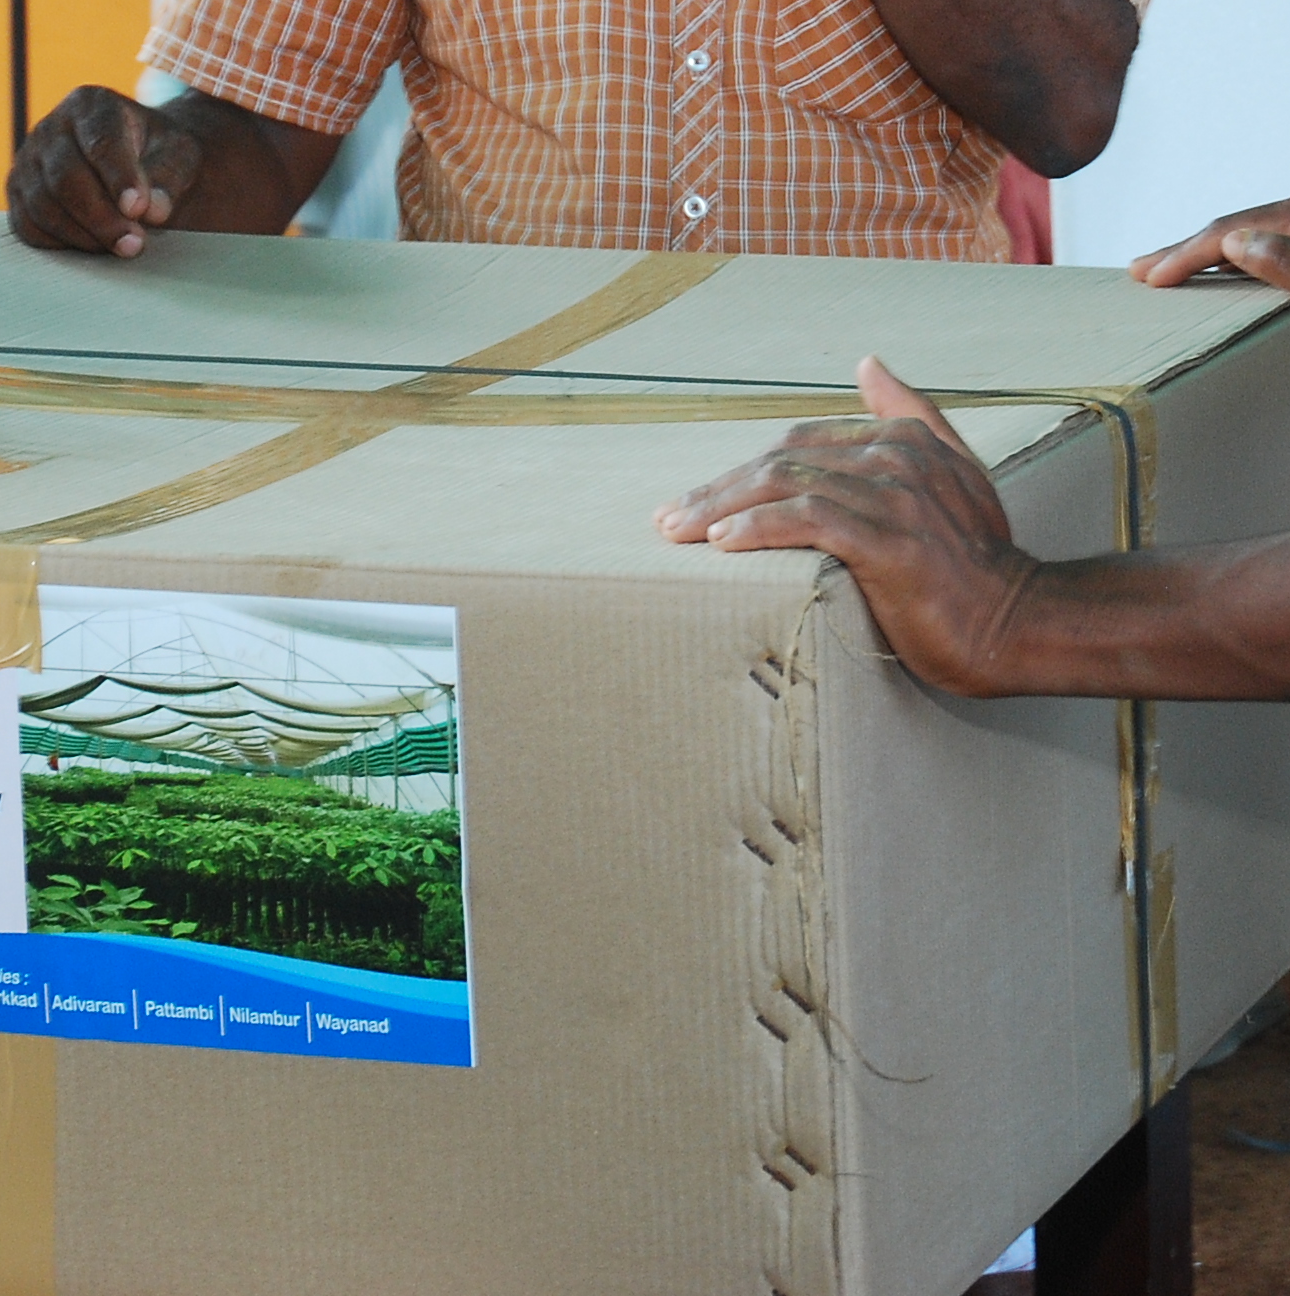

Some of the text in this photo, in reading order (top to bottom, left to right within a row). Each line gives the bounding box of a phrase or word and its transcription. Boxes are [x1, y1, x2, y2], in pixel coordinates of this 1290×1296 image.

[52, 995, 125, 1014] Adivaram
[145, 1001, 214, 1020] Pattambi
[230, 1007, 300, 1027] Nilambur
[315, 1013, 389, 1034] Wayanad
